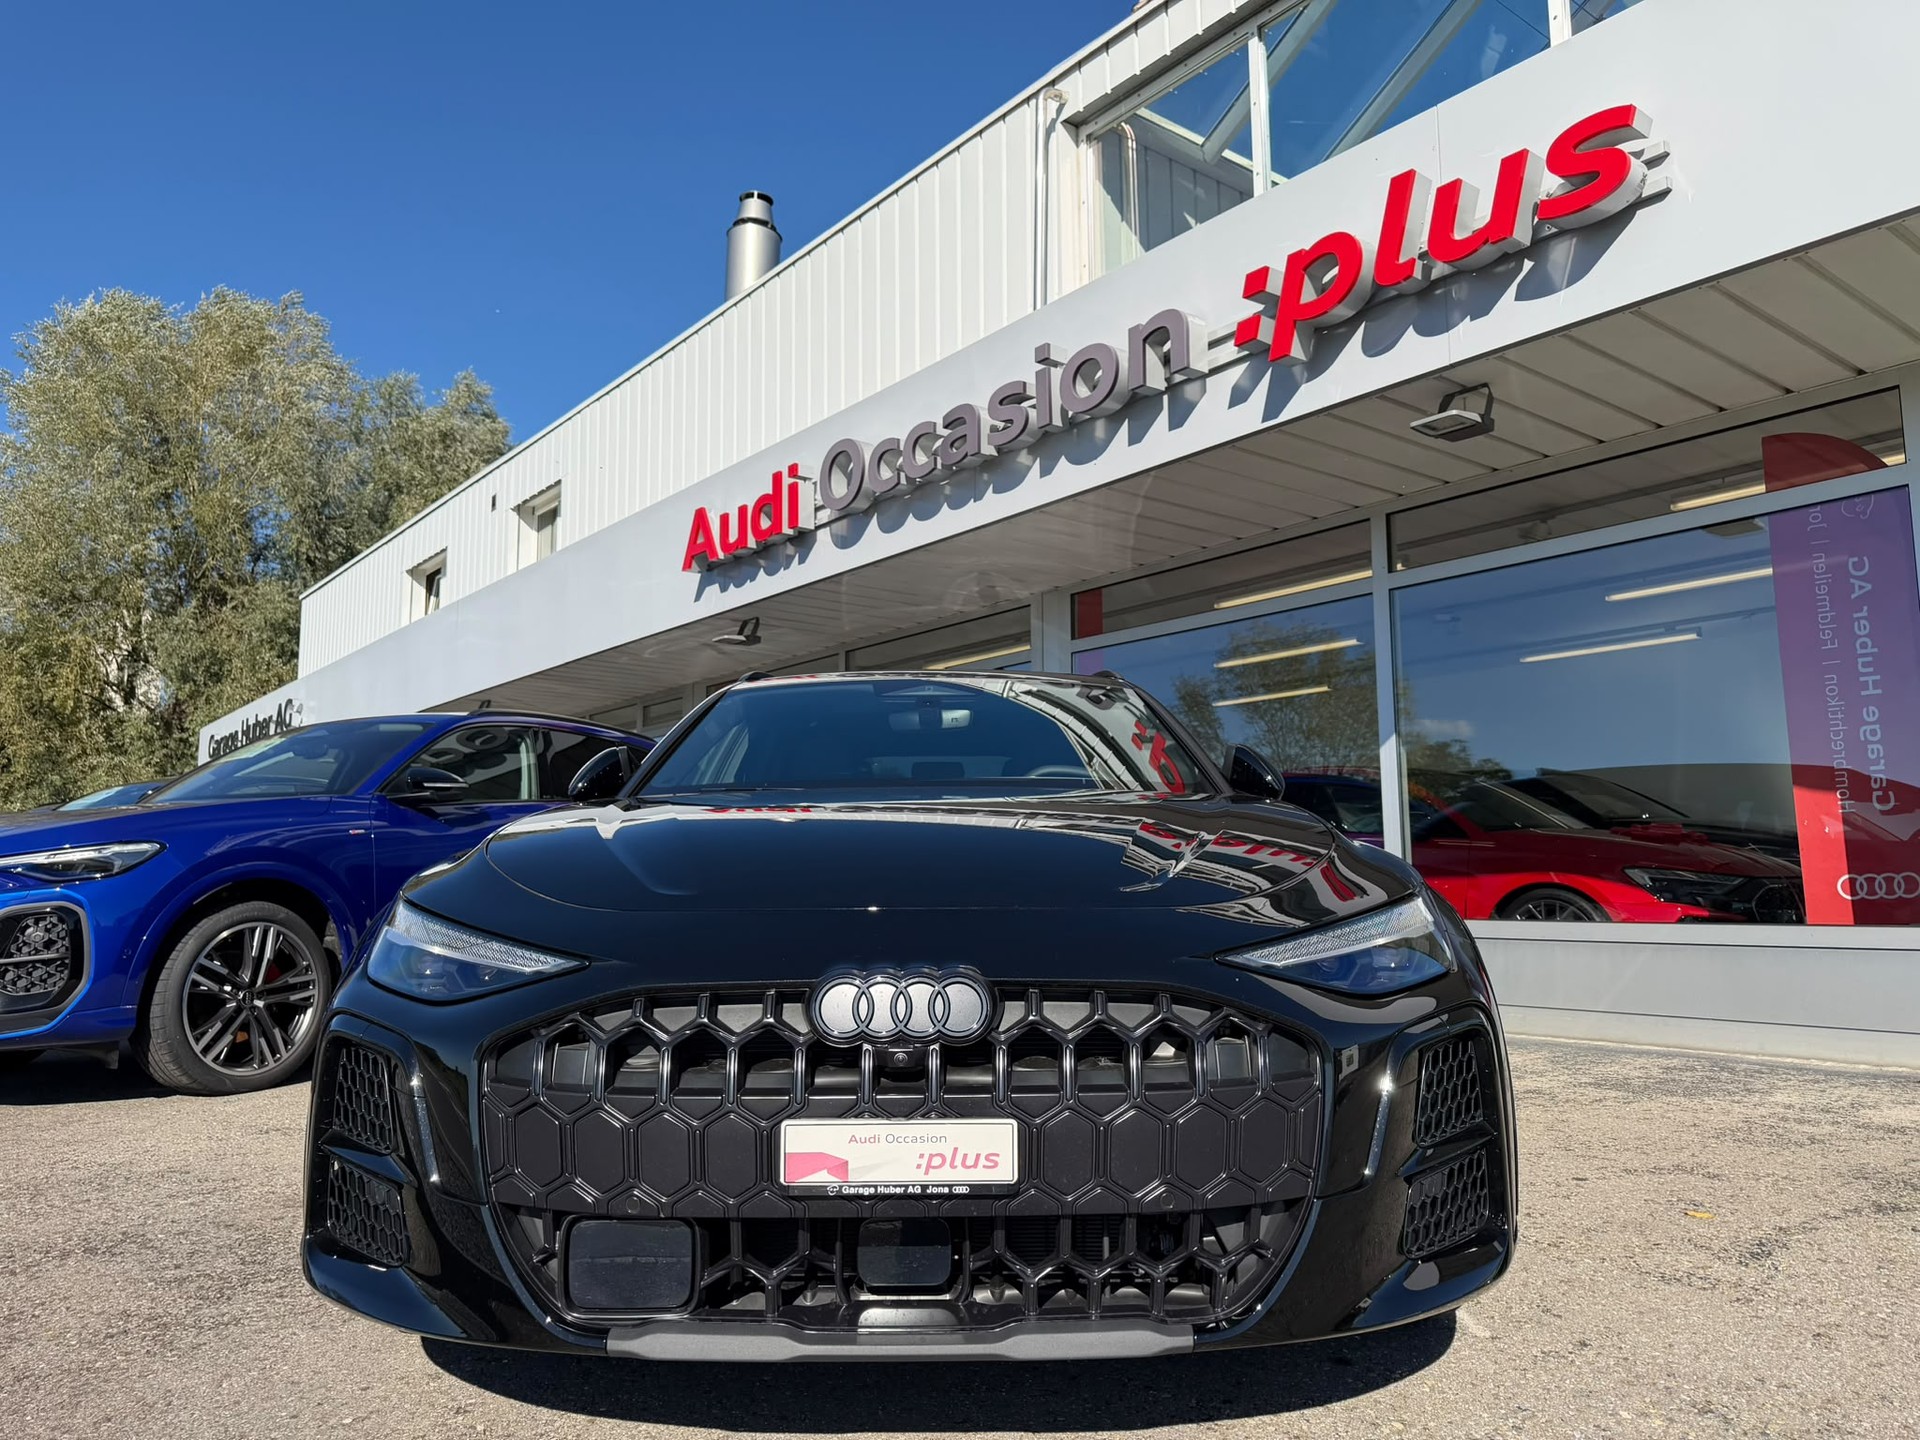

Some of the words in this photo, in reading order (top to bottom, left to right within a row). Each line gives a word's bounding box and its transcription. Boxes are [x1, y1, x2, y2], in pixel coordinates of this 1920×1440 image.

[682, 462, 801, 573] Audi
[819, 308, 1190, 511] Occasion
[1234, 103, 1638, 362] :plus
[241, 713, 274, 746] Huber
[274, 698, 294, 734] AG
[848, 1134, 881, 1144] Audi
[885, 1133, 947, 1144] Occasion
[915, 1147, 1001, 1176] :plus
[842, 1186, 875, 1195] Garage
[877, 1186, 905, 1194] Huber
[907, 1186, 921, 1194] AG
[926, 1186, 949, 1194] Jona
